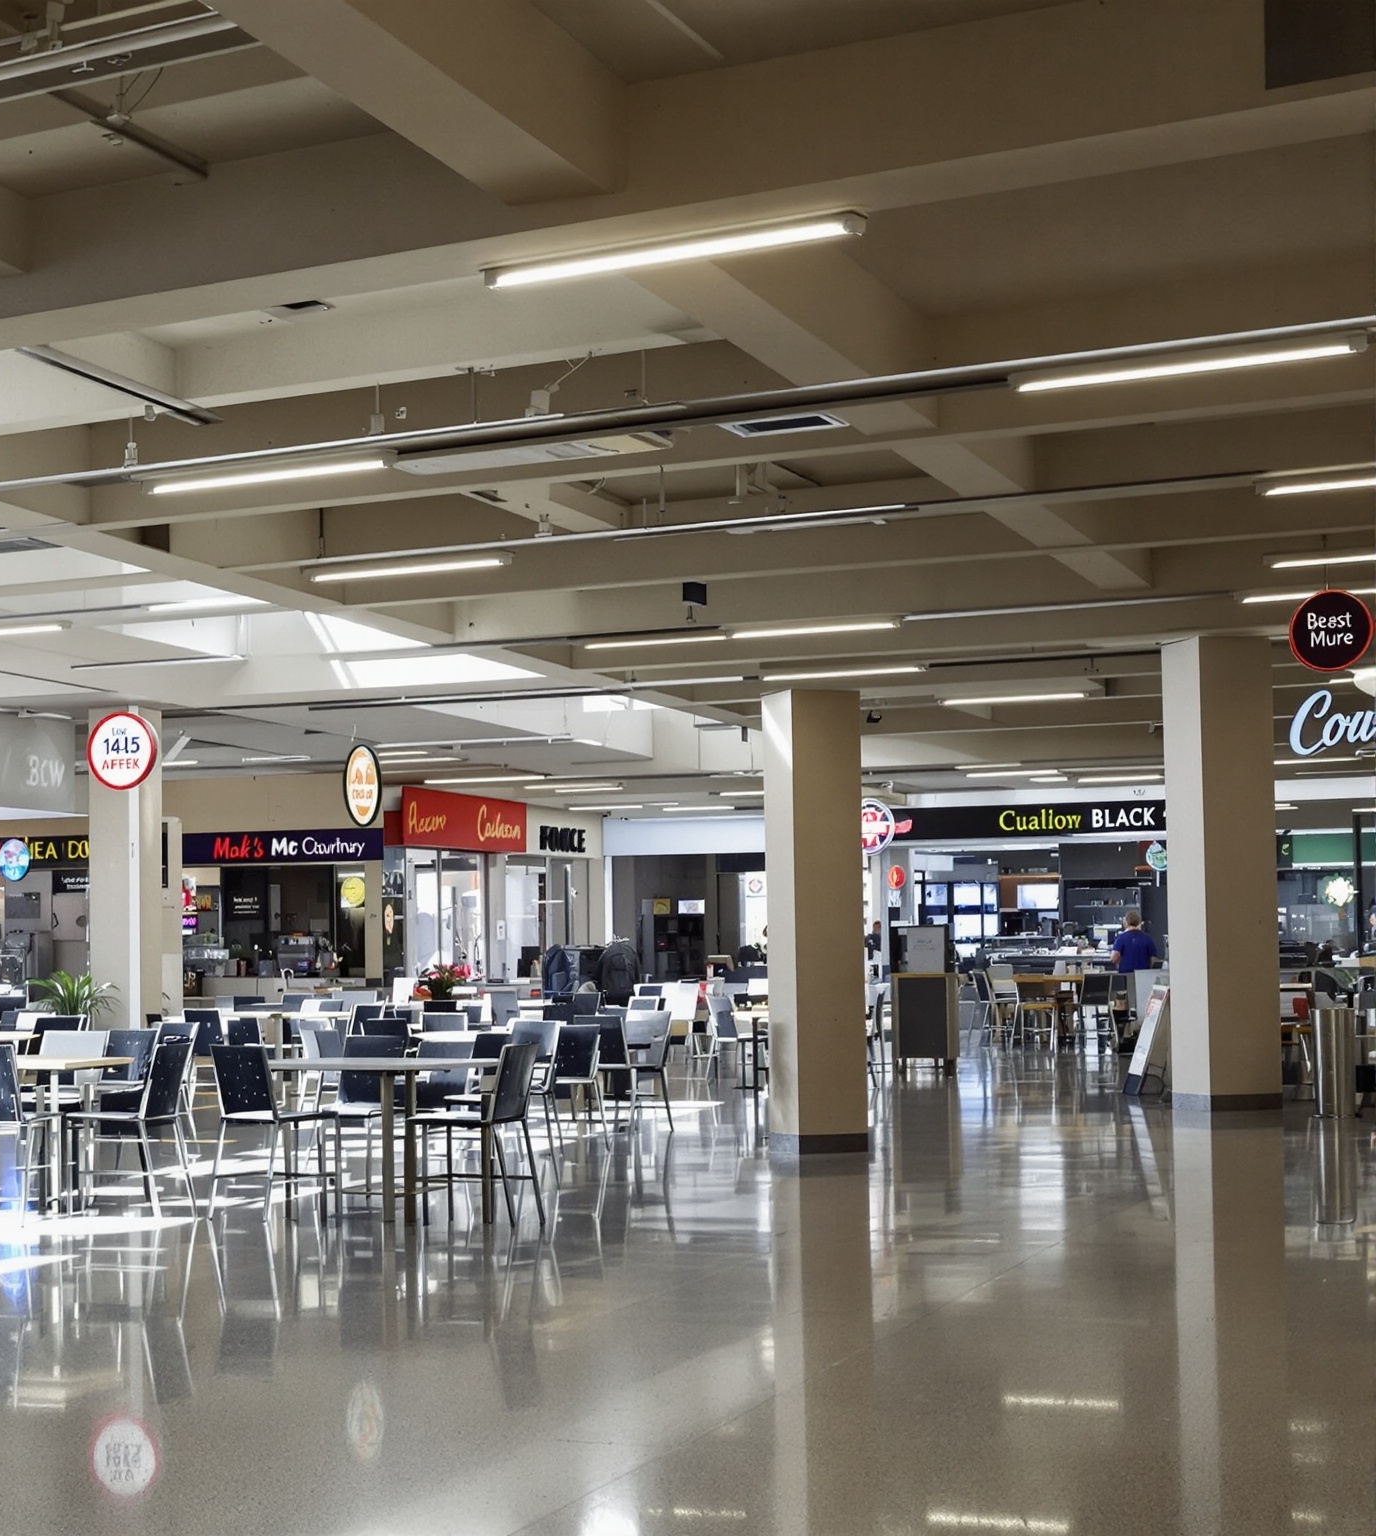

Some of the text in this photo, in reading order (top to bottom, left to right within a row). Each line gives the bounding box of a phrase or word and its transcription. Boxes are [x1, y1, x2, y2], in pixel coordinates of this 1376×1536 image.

[1310, 631, 1354, 648] Mure
[1290, 689, 1376, 756] Cou
[1091, 807, 1156, 828] BLACK
[271, 836, 299, 857] Mc
